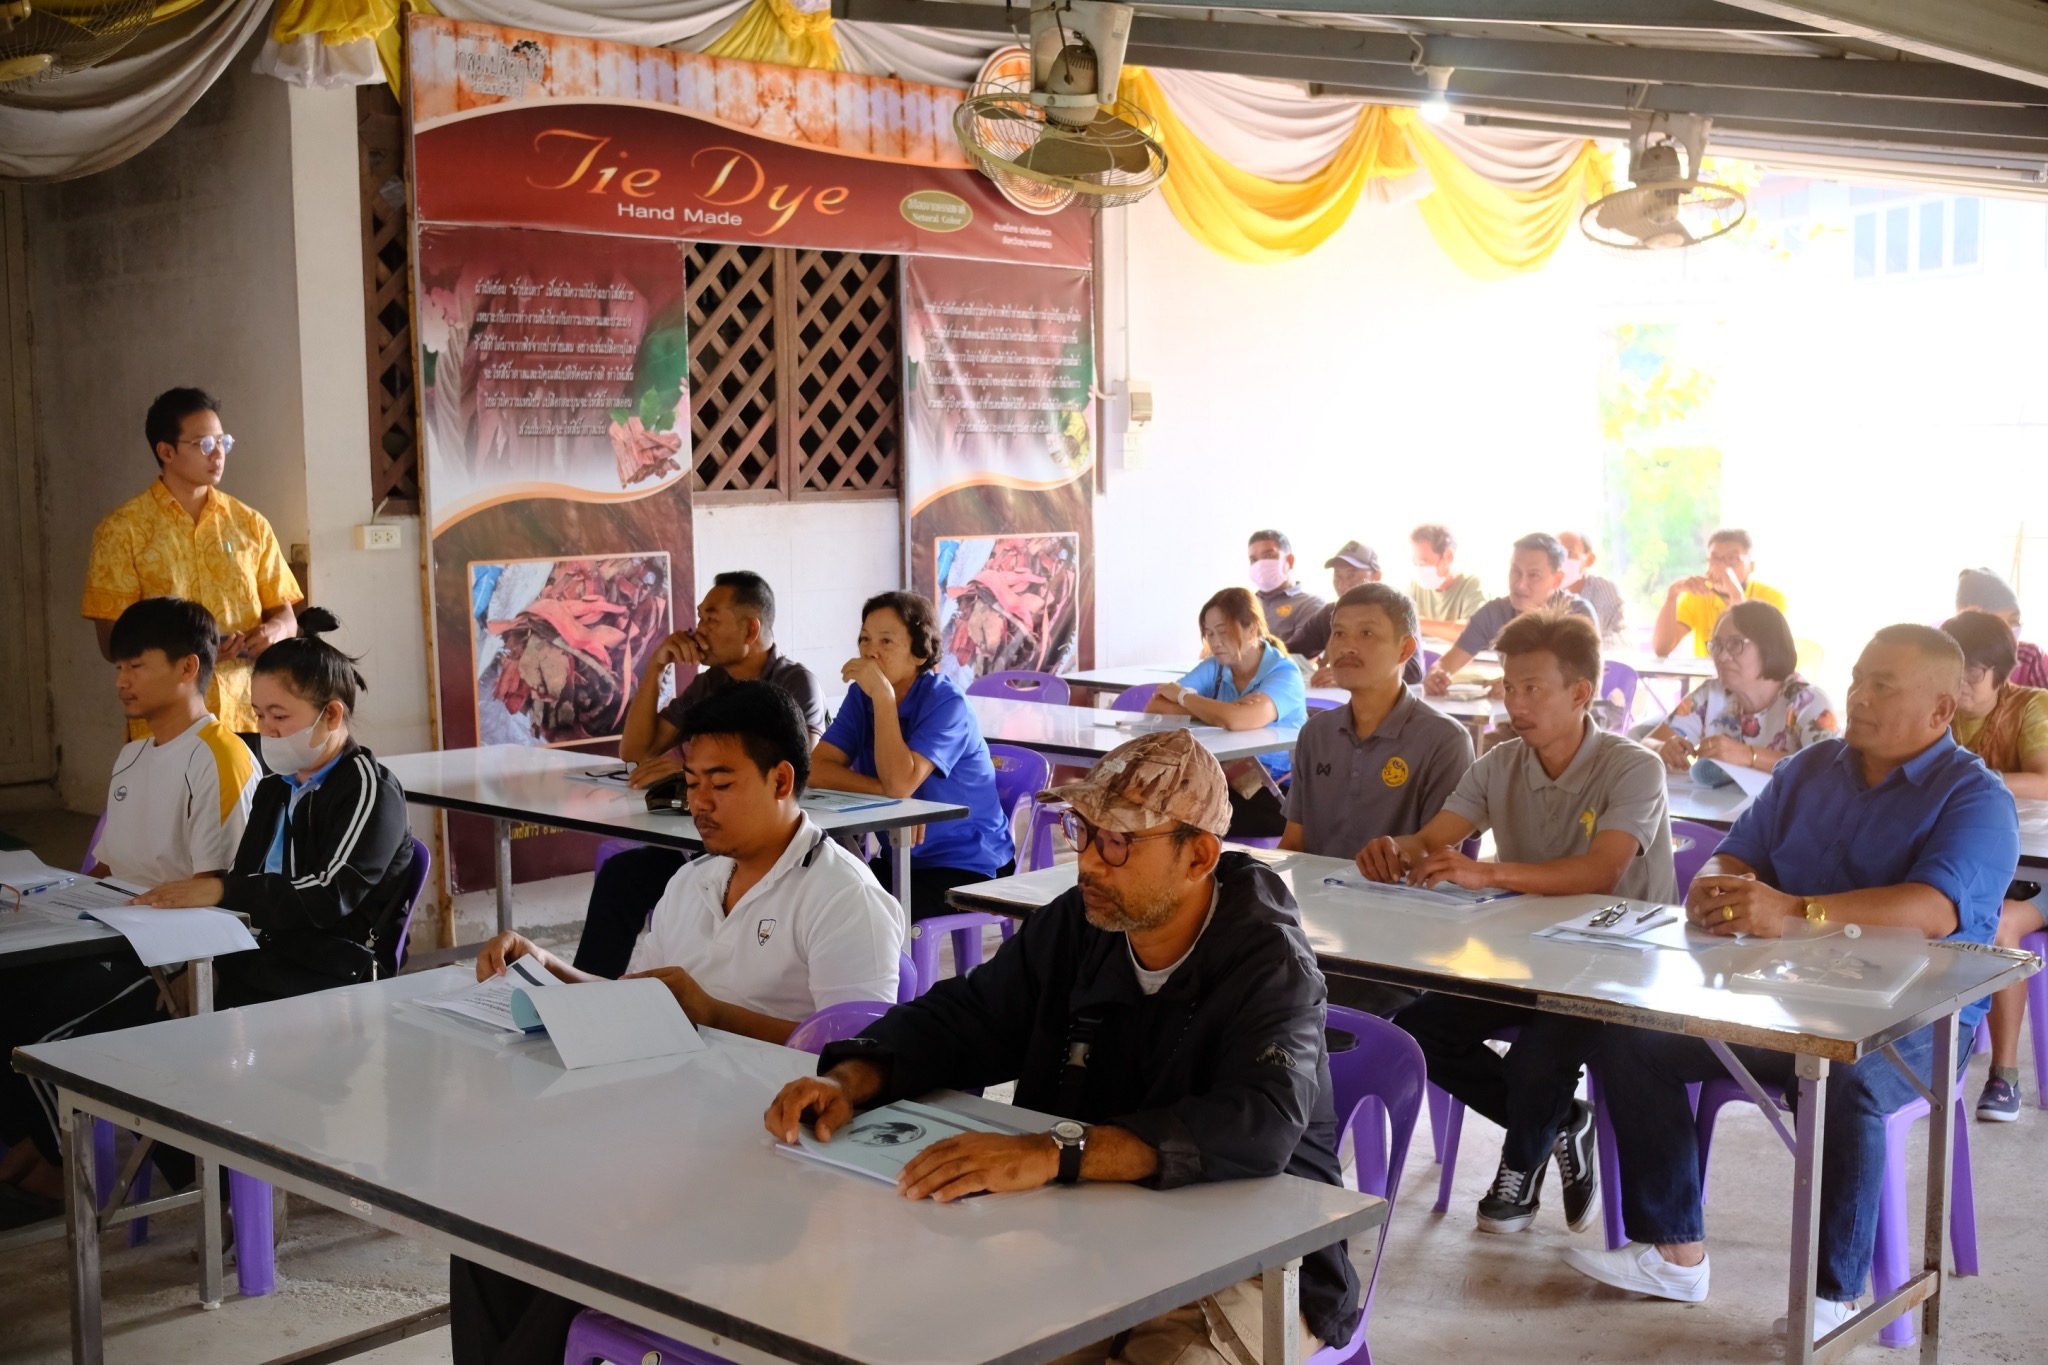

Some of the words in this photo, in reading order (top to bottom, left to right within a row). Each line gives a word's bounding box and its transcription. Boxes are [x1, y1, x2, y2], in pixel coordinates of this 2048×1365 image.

[526, 128, 662, 198] Tie
[690, 146, 850, 238] Dye
[617, 202, 675, 221] Hand
[683, 208, 743, 227] Made
[942, 215, 962, 225] Color
